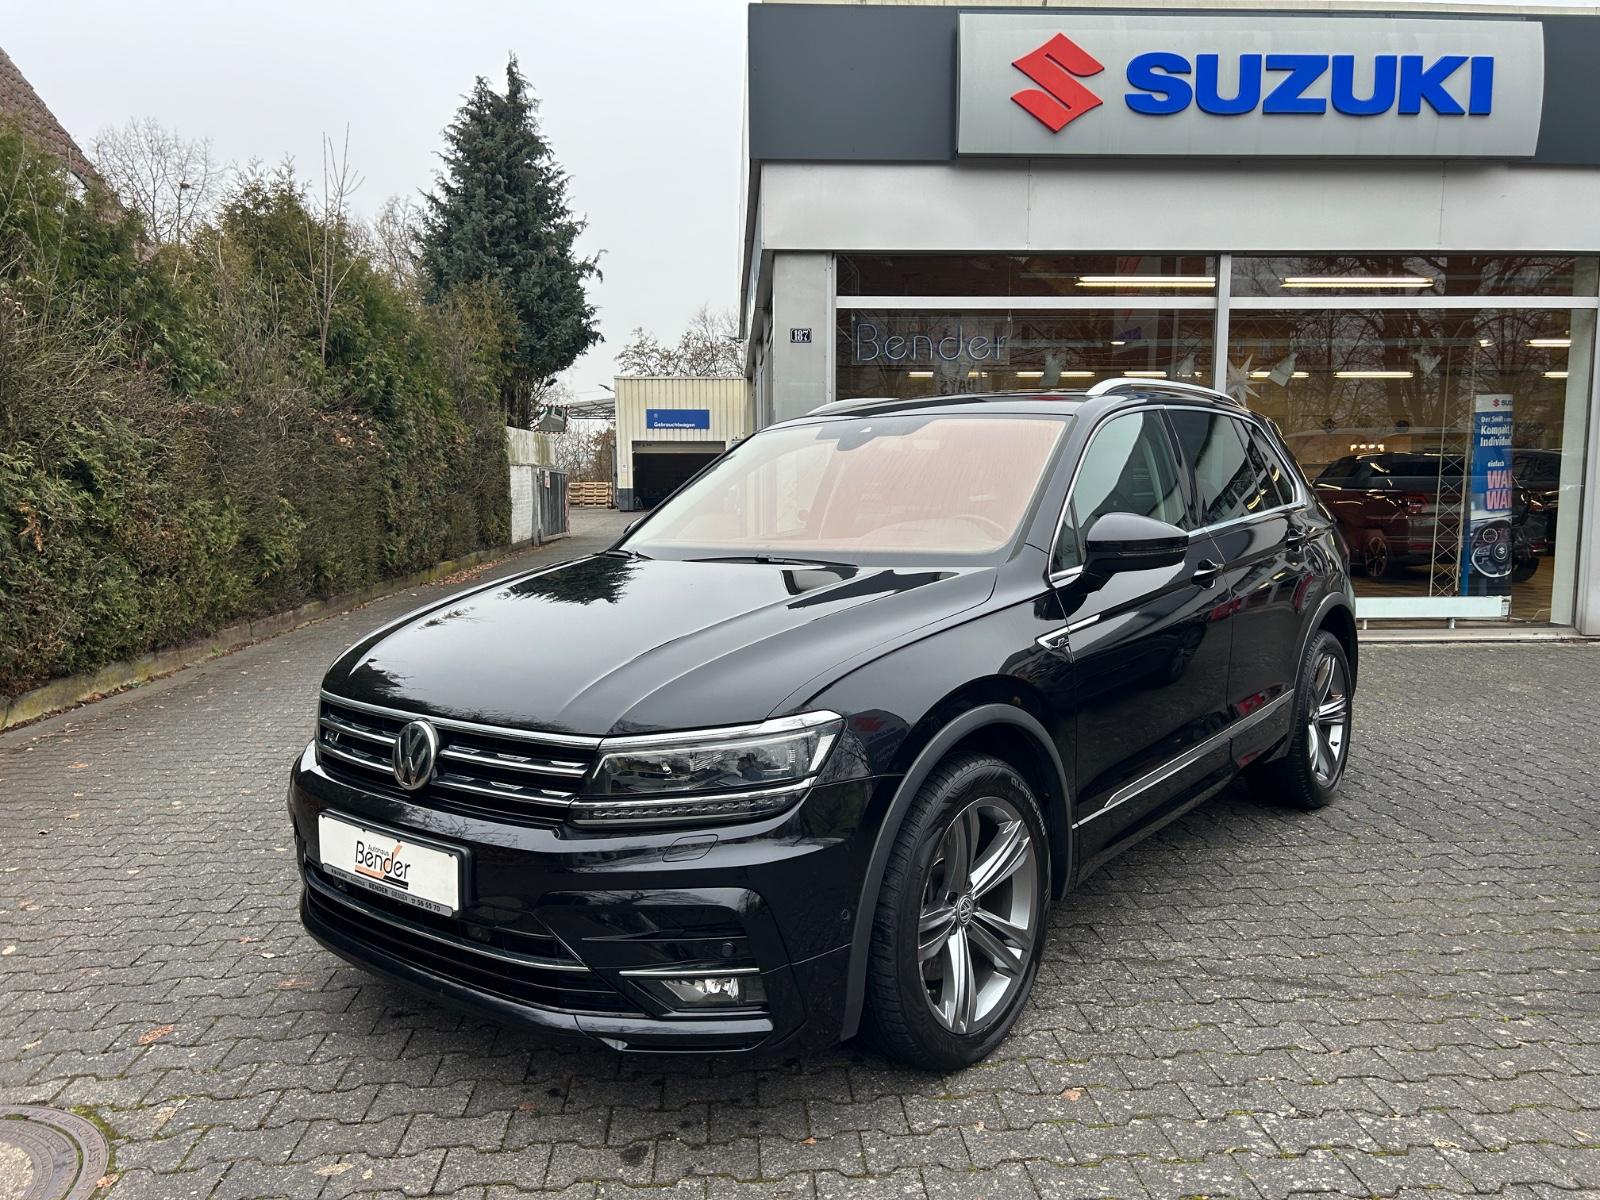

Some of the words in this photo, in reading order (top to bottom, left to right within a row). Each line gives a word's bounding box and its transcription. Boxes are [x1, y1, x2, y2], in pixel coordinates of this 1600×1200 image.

[1125, 51, 1495, 117] SUZUKI
[794, 329, 809, 342] 187
[856, 323, 1009, 361] Bender
[355, 840, 411, 879] Bender
[368, 883, 388, 893] BENDER
